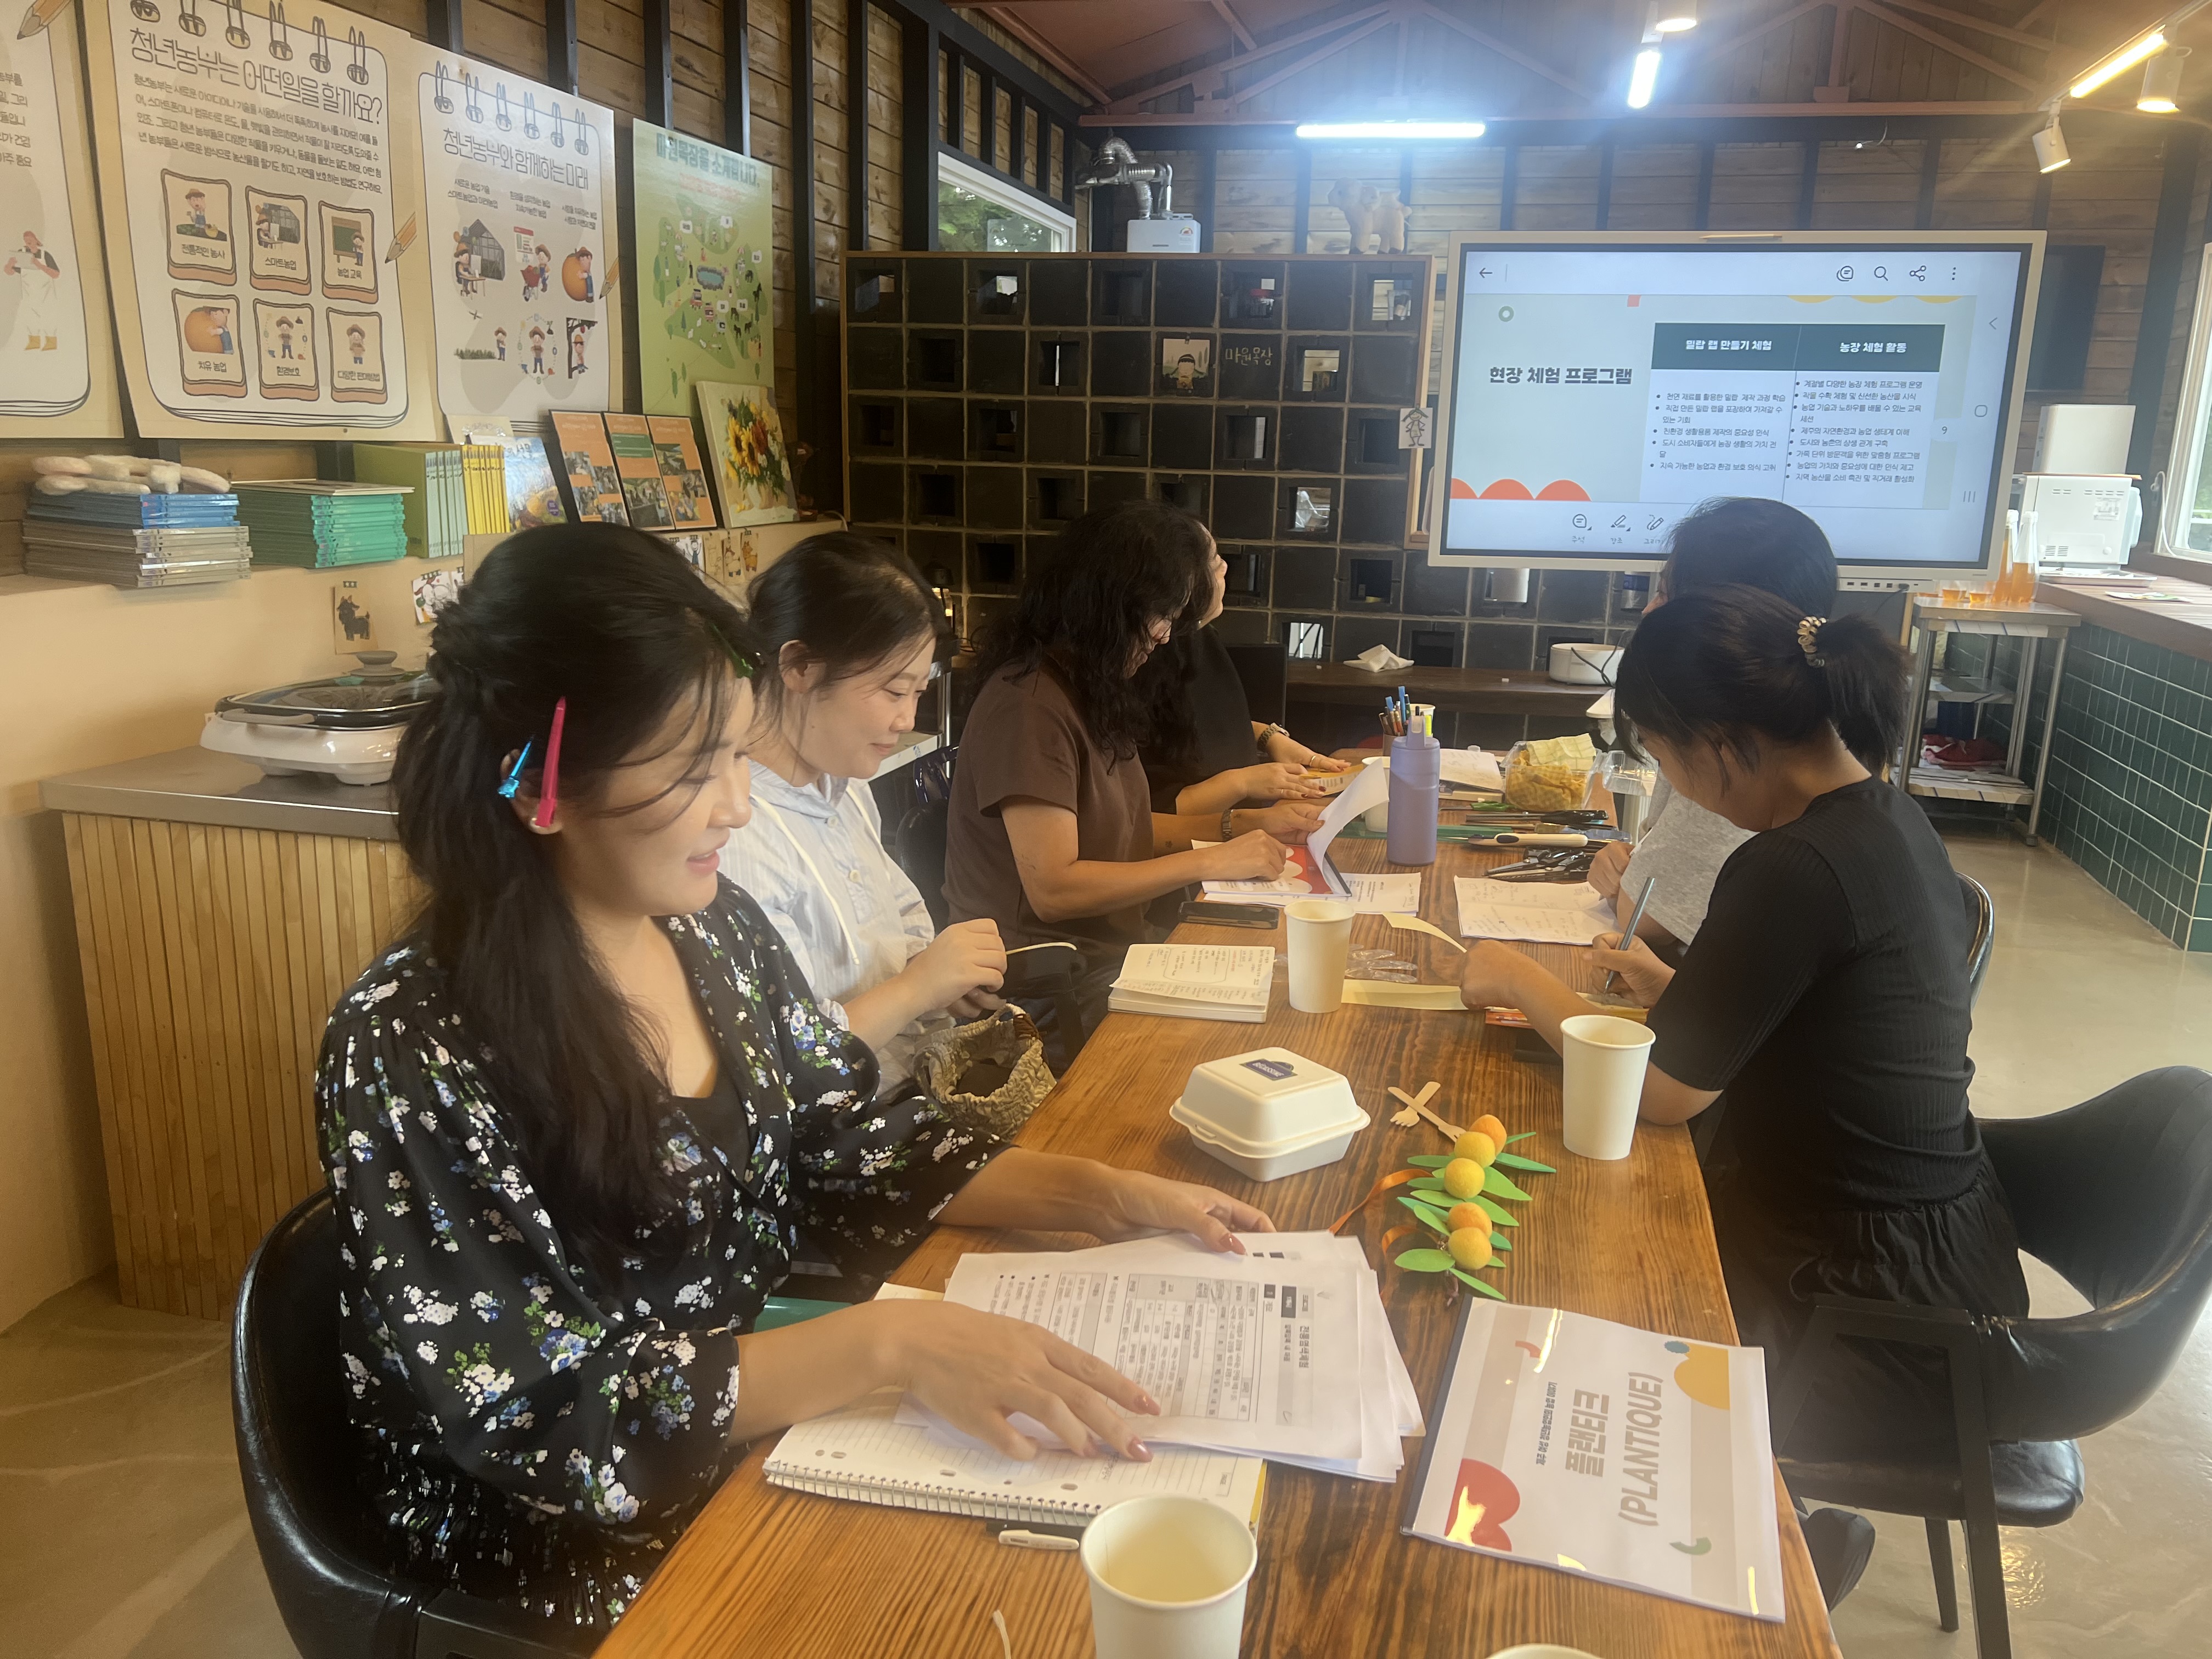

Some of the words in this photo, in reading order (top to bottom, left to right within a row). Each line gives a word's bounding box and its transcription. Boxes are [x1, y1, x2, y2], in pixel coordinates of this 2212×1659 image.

[130, 27, 240, 86] 청년농부는
[243, 60, 319, 108] 어떤일을
[322, 82, 382, 125] 할까요?
[156, 116, 178, 131] 그리고
[373, 152, 379, 162] 수
[443, 128, 514, 170] 청년농부와
[515, 148, 565, 184] 함께하는
[566, 163, 588, 190] 미래
[265, 257, 297, 270] 스마트농업
[337, 267, 349, 278] 농업
[1686, 340, 1706, 349] 밀랍
[1708, 340, 1718, 350] 랩
[1720, 340, 1750, 350] 만들기
[1752, 341, 1772, 351] 체험
[1840, 342, 1860, 353] 농장
[1863, 342, 1883, 353] 체험
[1886, 343, 1906, 353] 활동
[1225, 347, 1273, 366] 마원목장
[198, 360, 212, 371] 치유
[213, 362, 227, 373] 농업
[1489, 366, 1523, 383] 현장
[1527, 366, 1560, 383] 체험
[1565, 368, 1632, 385] 프로그램
[1942, 426, 1948, 435] 9
[1572, 535, 1585, 544] 주석
[1547, 1381, 1558, 1397] 이야기
[1545, 1397, 1555, 1409] 농업
[1565, 1389, 1610, 1477] 플랜티크
[1538, 1441, 1549, 1453] 여성
[1618, 1372, 1663, 1526] (PLANTIQUE)
[1536, 1453, 1547, 1465] 제주
